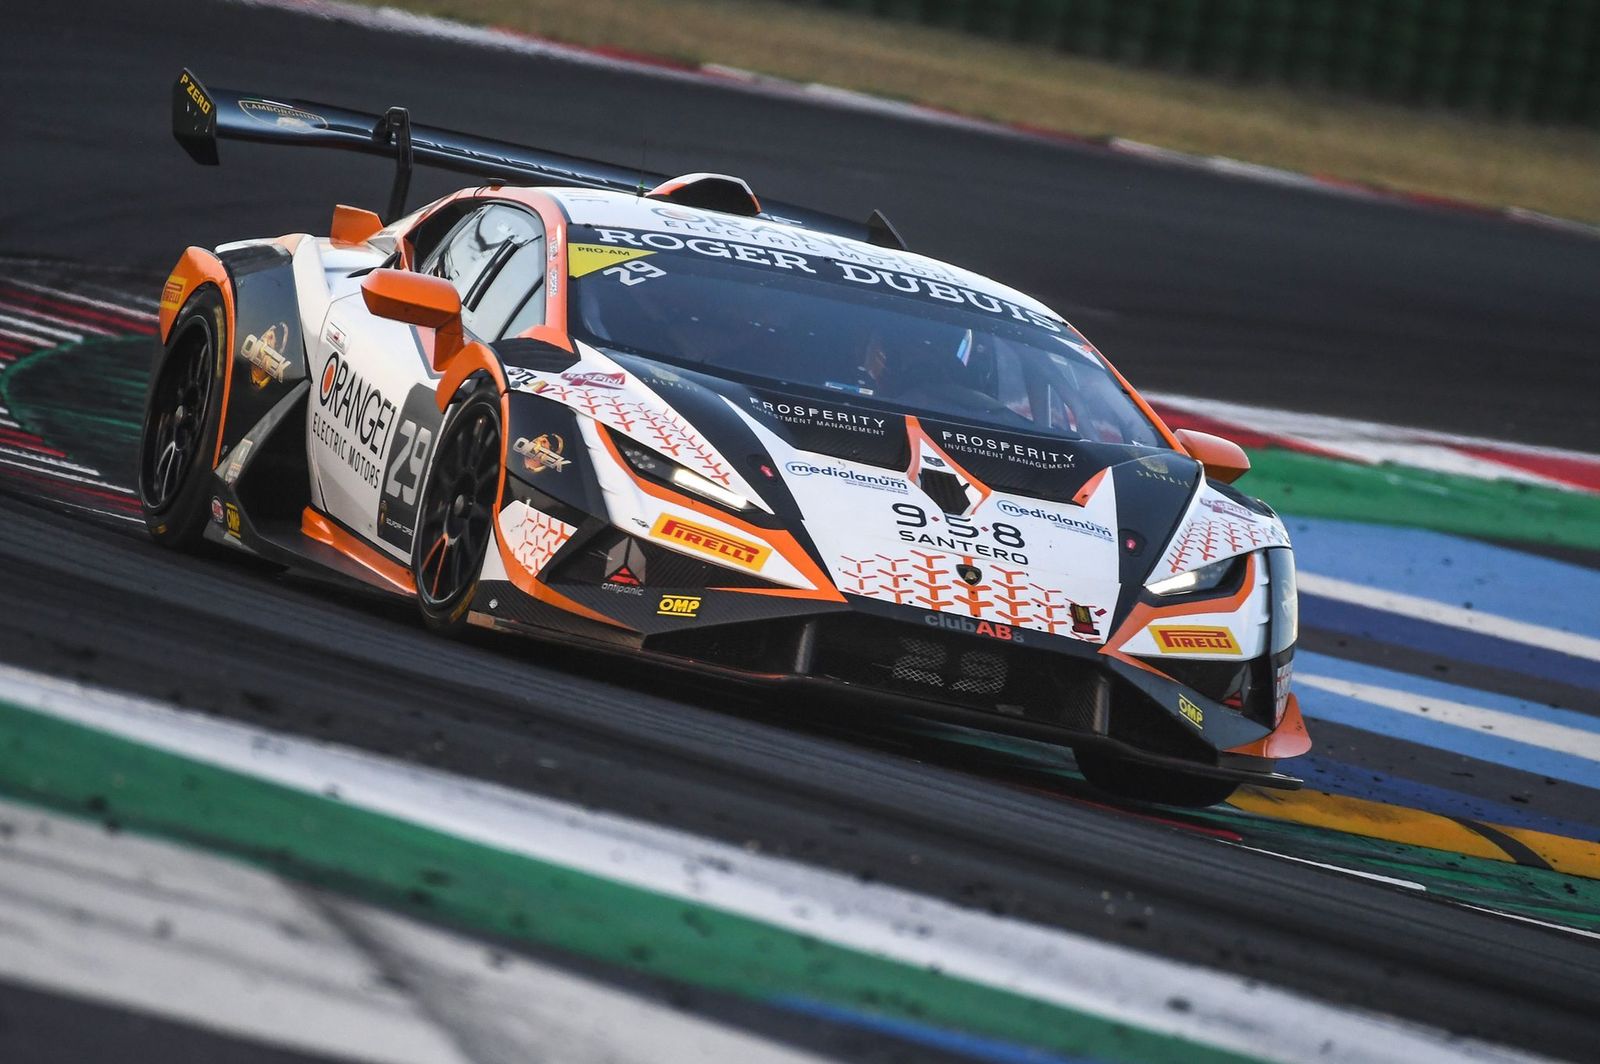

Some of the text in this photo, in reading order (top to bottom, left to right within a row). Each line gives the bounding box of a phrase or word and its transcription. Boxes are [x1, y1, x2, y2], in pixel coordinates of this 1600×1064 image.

[180, 73, 212, 115] P ZERO
[577, 246, 631, 256] PRO-AM
[664, 219, 969, 287] ELECTRIC MOTORS
[594, 228, 817, 273] ROGER
[834, 260, 1062, 332] DUBUIS
[602, 260, 667, 287] 29
[565, 372, 622, 386] RASPINI
[319, 351, 397, 460] ORANGE1
[750, 396, 886, 428] PROSPERITY
[752, 405, 886, 437] INVESTMENT MANAGEMENT
[312, 412, 381, 490] ELECTRIC MOTORS
[942, 430, 1075, 462] PROSPERITY
[944, 442, 1076, 470] INVESTMENT MANAGEMENT
[385, 419, 432, 506] 29
[791, 462, 908, 490] mediolanum
[1002, 502, 1113, 537] mediolanum
[661, 519, 761, 563] PIRELLI
[898, 530, 1029, 565] SANTERO
[601, 581, 645, 597] antipanic
[658, 598, 700, 614] OMP
[1158, 630, 1233, 649] PIRELLI
[1178, 698, 1204, 724] OMP
